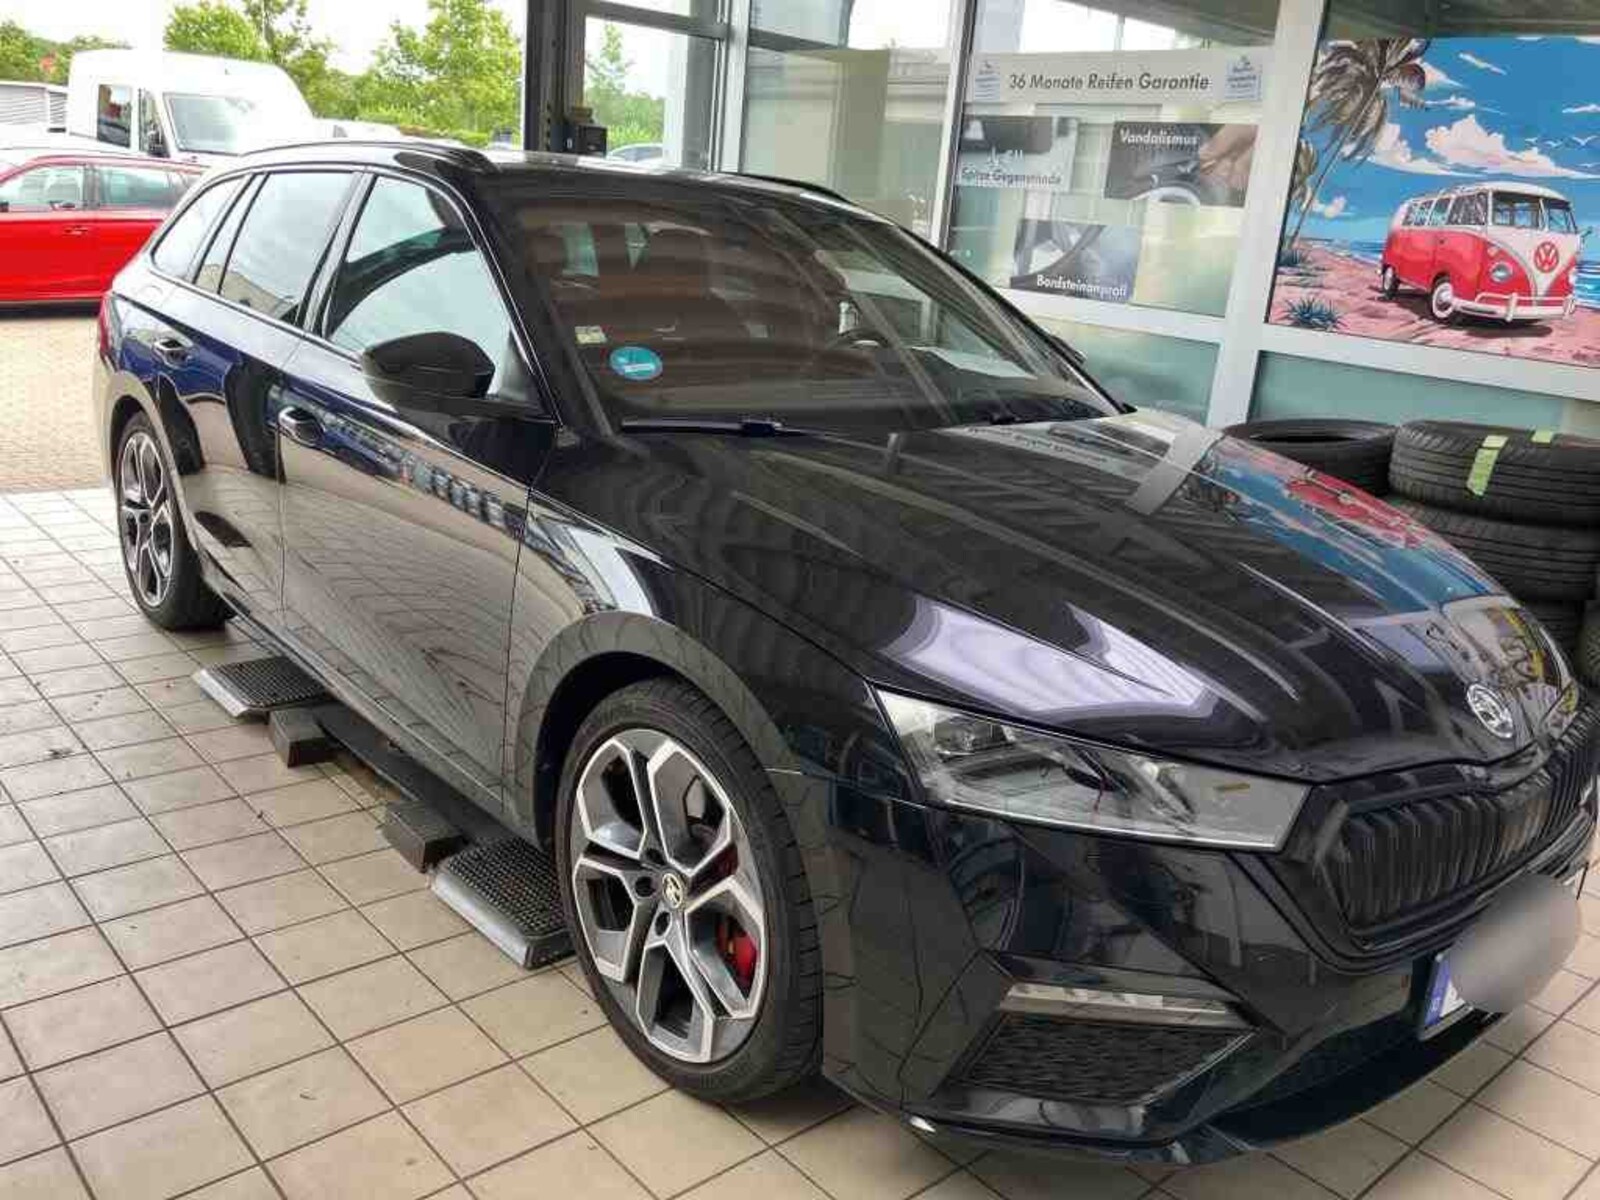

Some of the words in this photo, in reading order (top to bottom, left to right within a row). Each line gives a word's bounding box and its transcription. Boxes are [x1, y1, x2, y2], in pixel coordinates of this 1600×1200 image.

[1009, 73, 1026, 89] 36
[1029, 74, 1083, 89] Monate
[1087, 72, 1133, 89] Reifen
[1138, 72, 1209, 90] Garantie
[1119, 127, 1199, 145] Vandalismus
